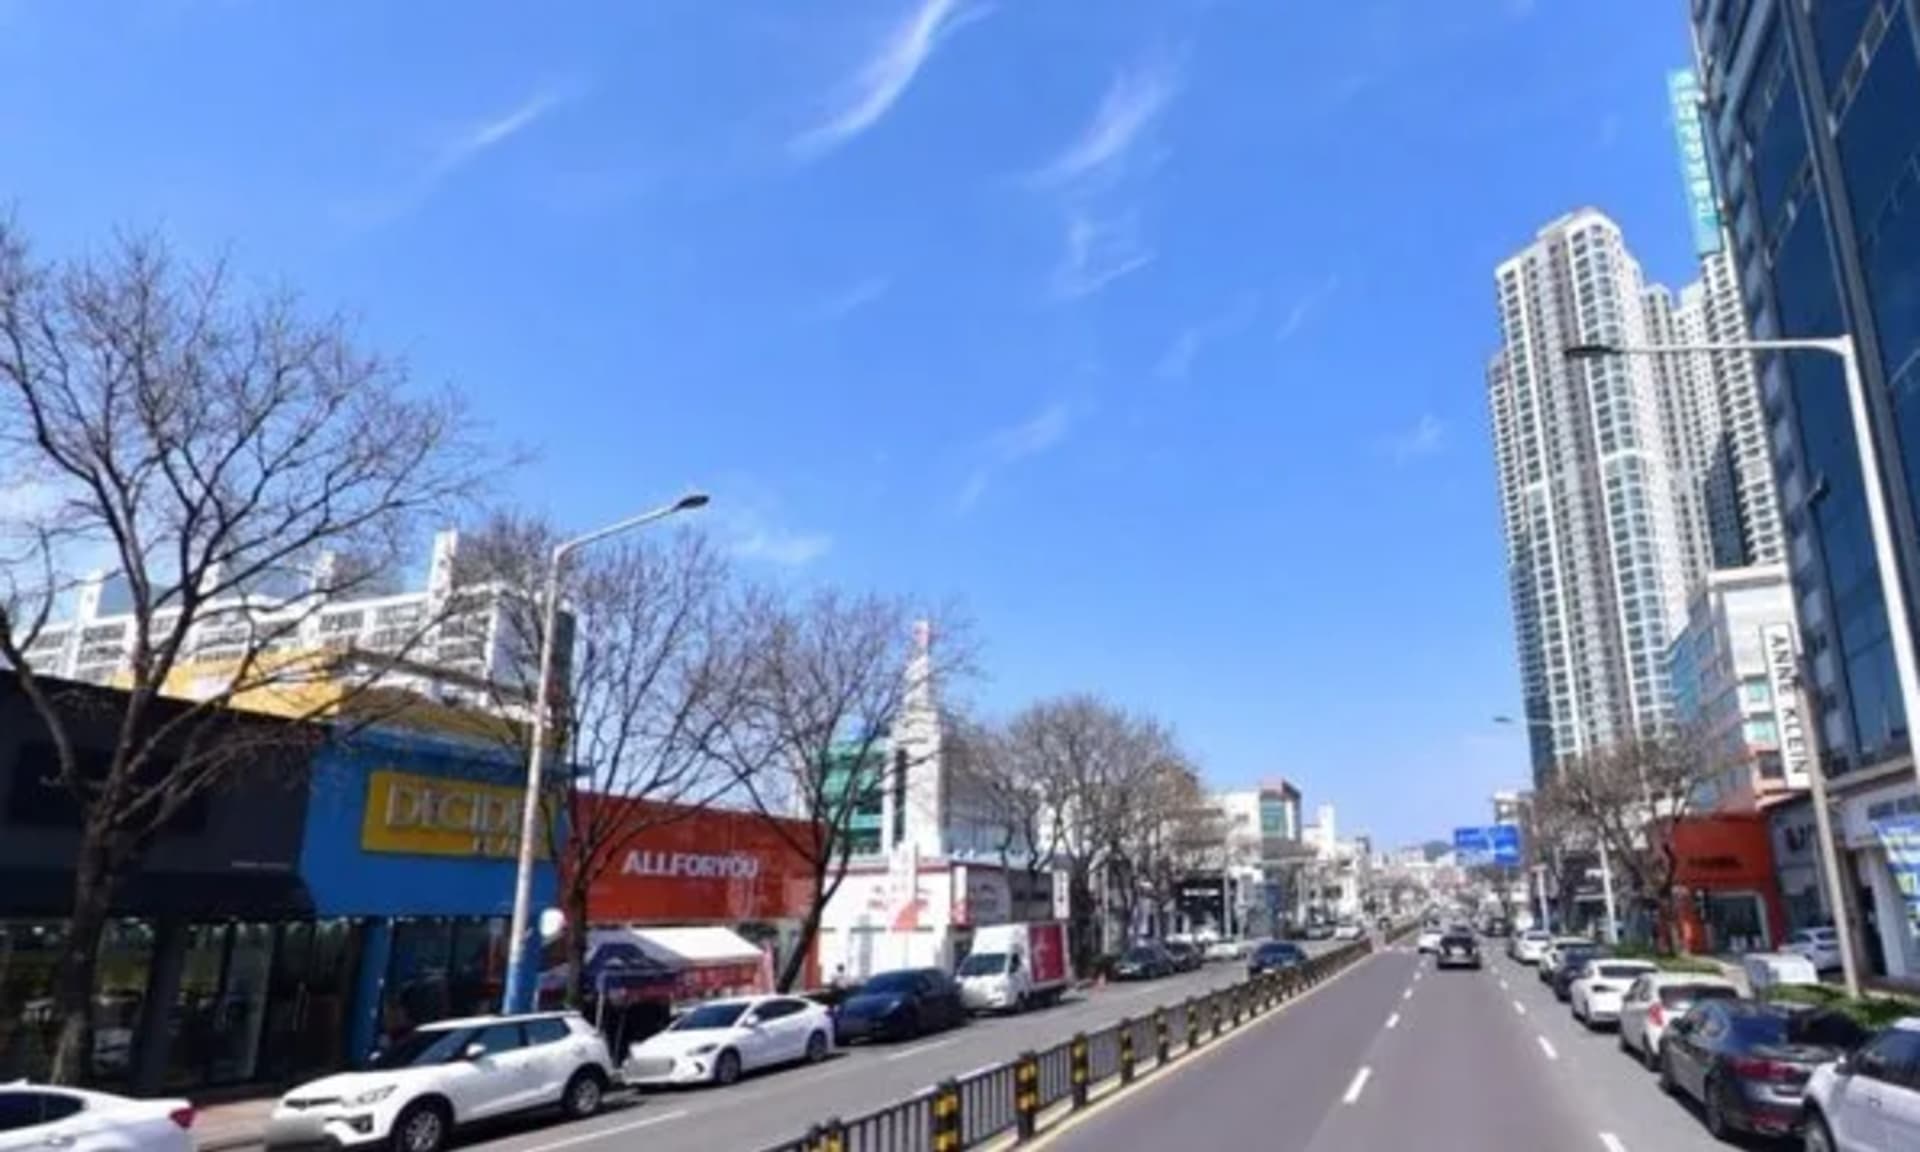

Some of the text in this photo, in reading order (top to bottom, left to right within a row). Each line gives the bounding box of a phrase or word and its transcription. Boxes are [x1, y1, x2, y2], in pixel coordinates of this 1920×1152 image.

[1771, 635, 1809, 775] ANNE KLEIN
[622, 851, 759, 879] ALLFORYOU
